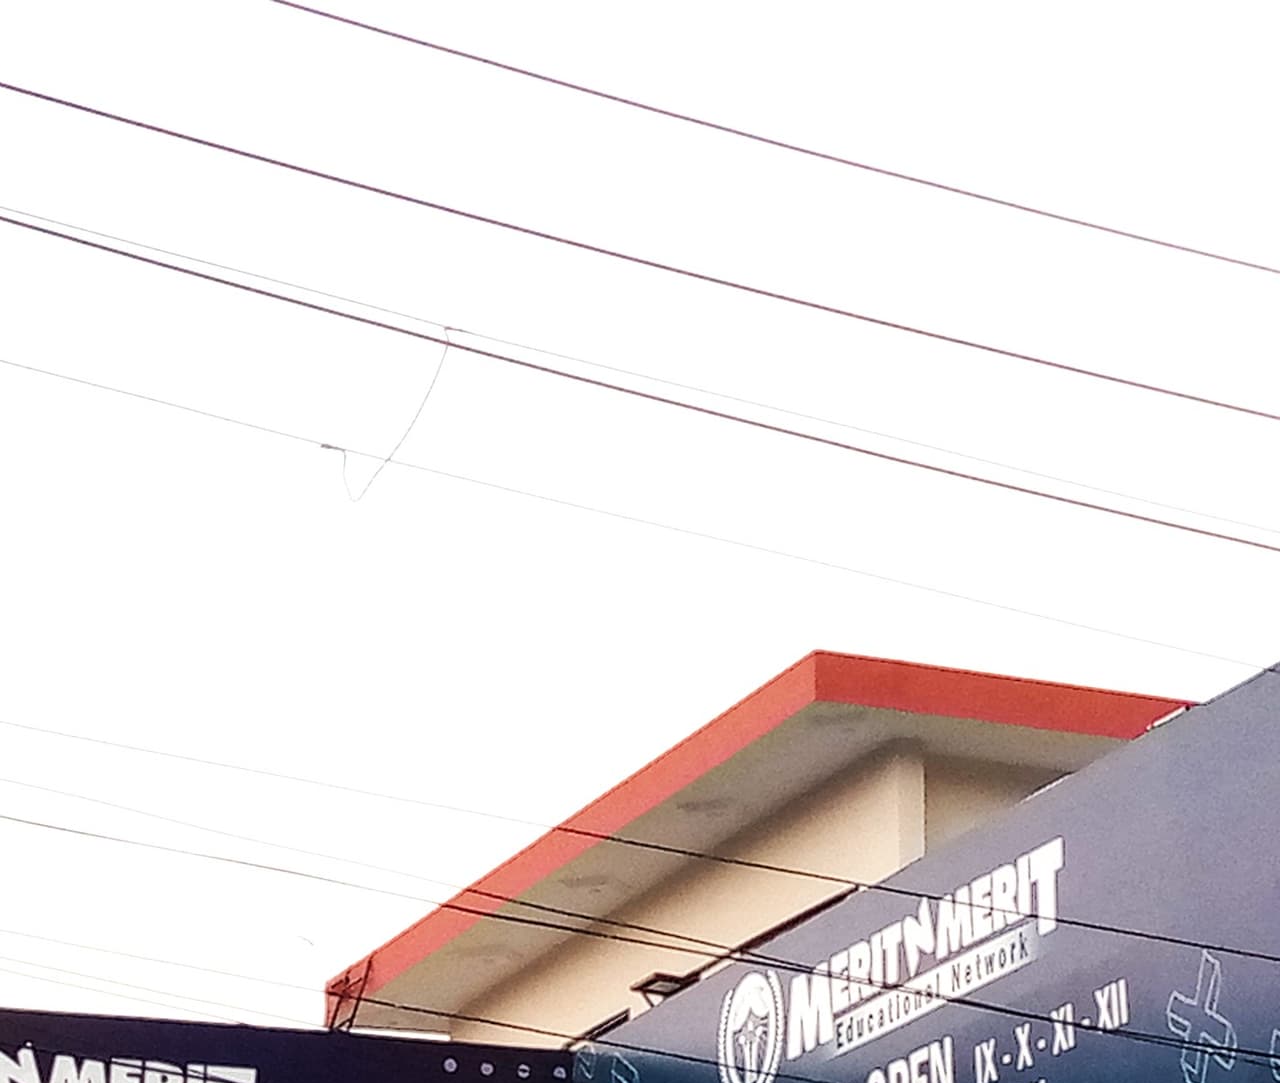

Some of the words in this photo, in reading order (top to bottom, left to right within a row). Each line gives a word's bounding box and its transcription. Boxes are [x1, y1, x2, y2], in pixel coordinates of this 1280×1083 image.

[786, 921, 904, 1060] MERIT
[902, 896, 936, 977] N
[936, 835, 1064, 960] MERIT
[836, 974, 940, 1049] Educational
[951, 931, 1031, 992] Network
[1015, 1022, 1034, 1070] X
[1050, 1003, 1076, 1056] XI
[1093, 978, 1129, 1031] XII
